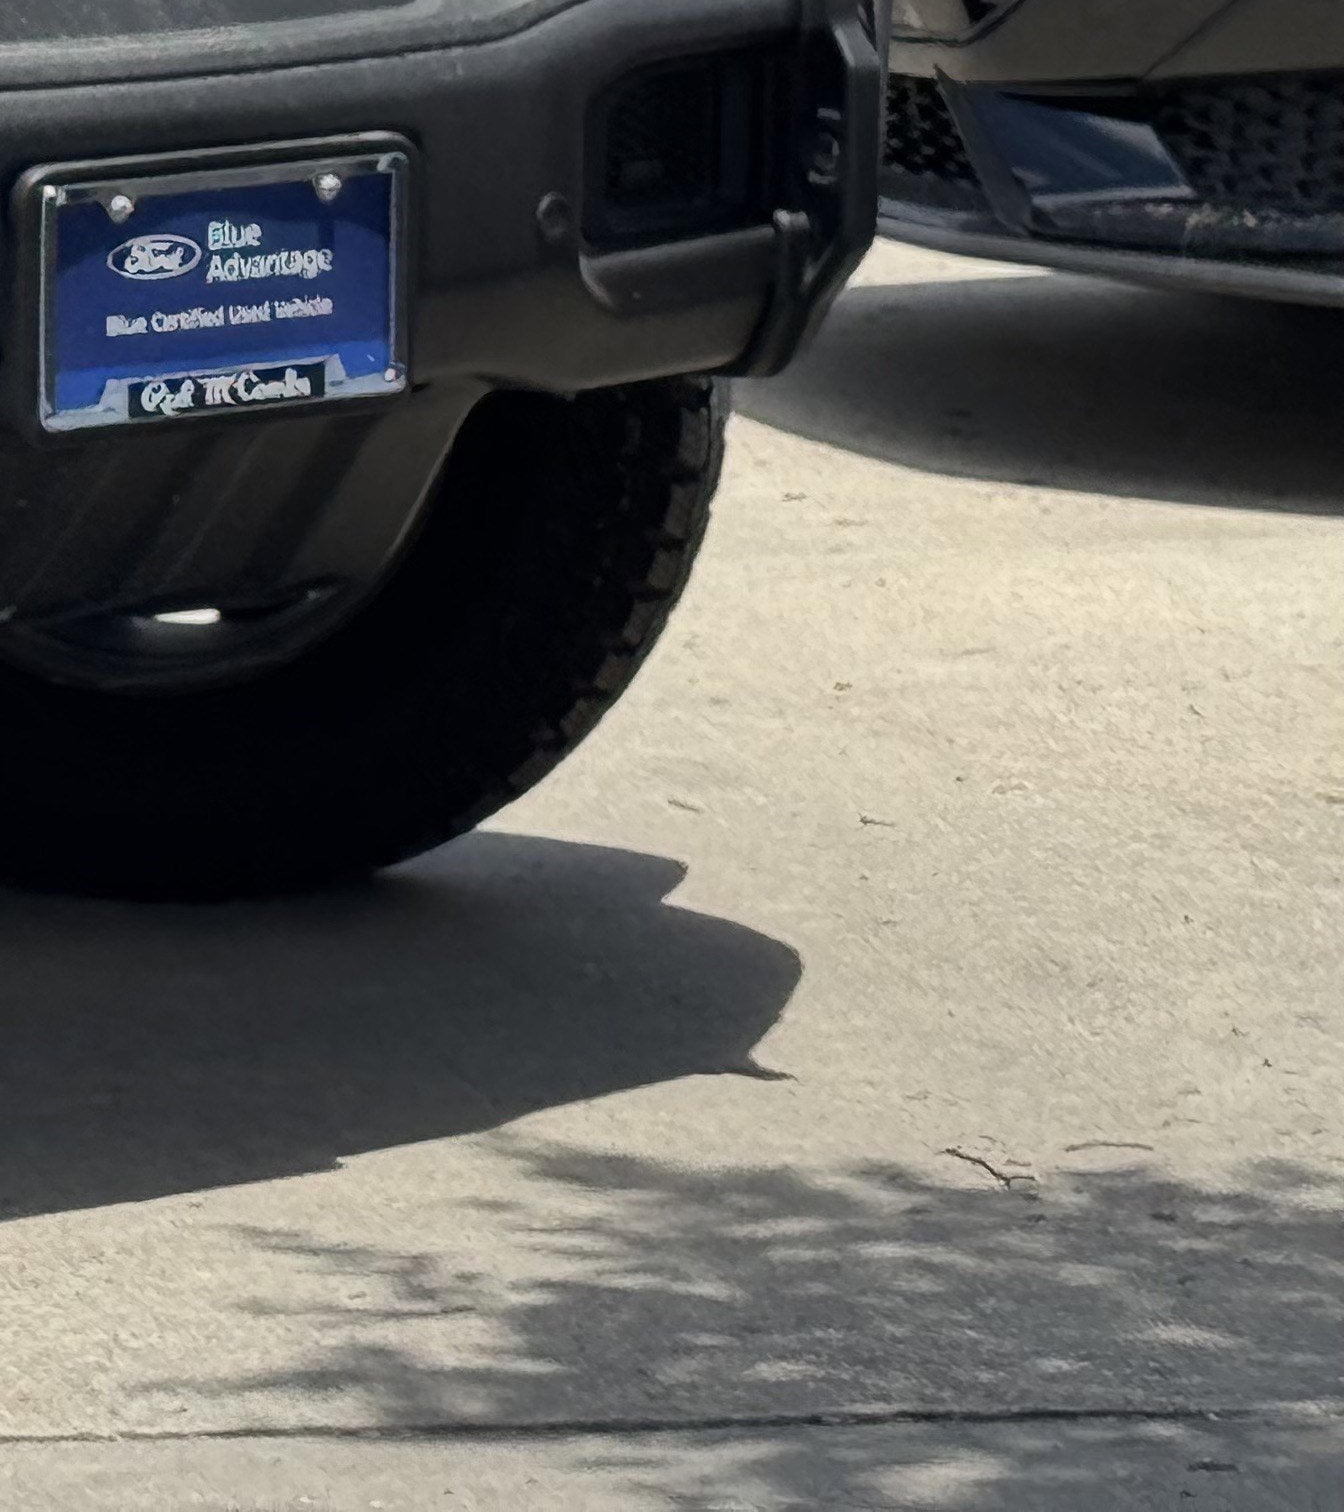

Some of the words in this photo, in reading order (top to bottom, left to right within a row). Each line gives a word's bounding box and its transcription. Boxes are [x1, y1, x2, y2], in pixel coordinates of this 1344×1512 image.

[207, 220, 262, 248] Blue
[205, 247, 333, 284] Advantage
[105, 312, 148, 337] Blue
[150, 305, 224, 334] Certified
